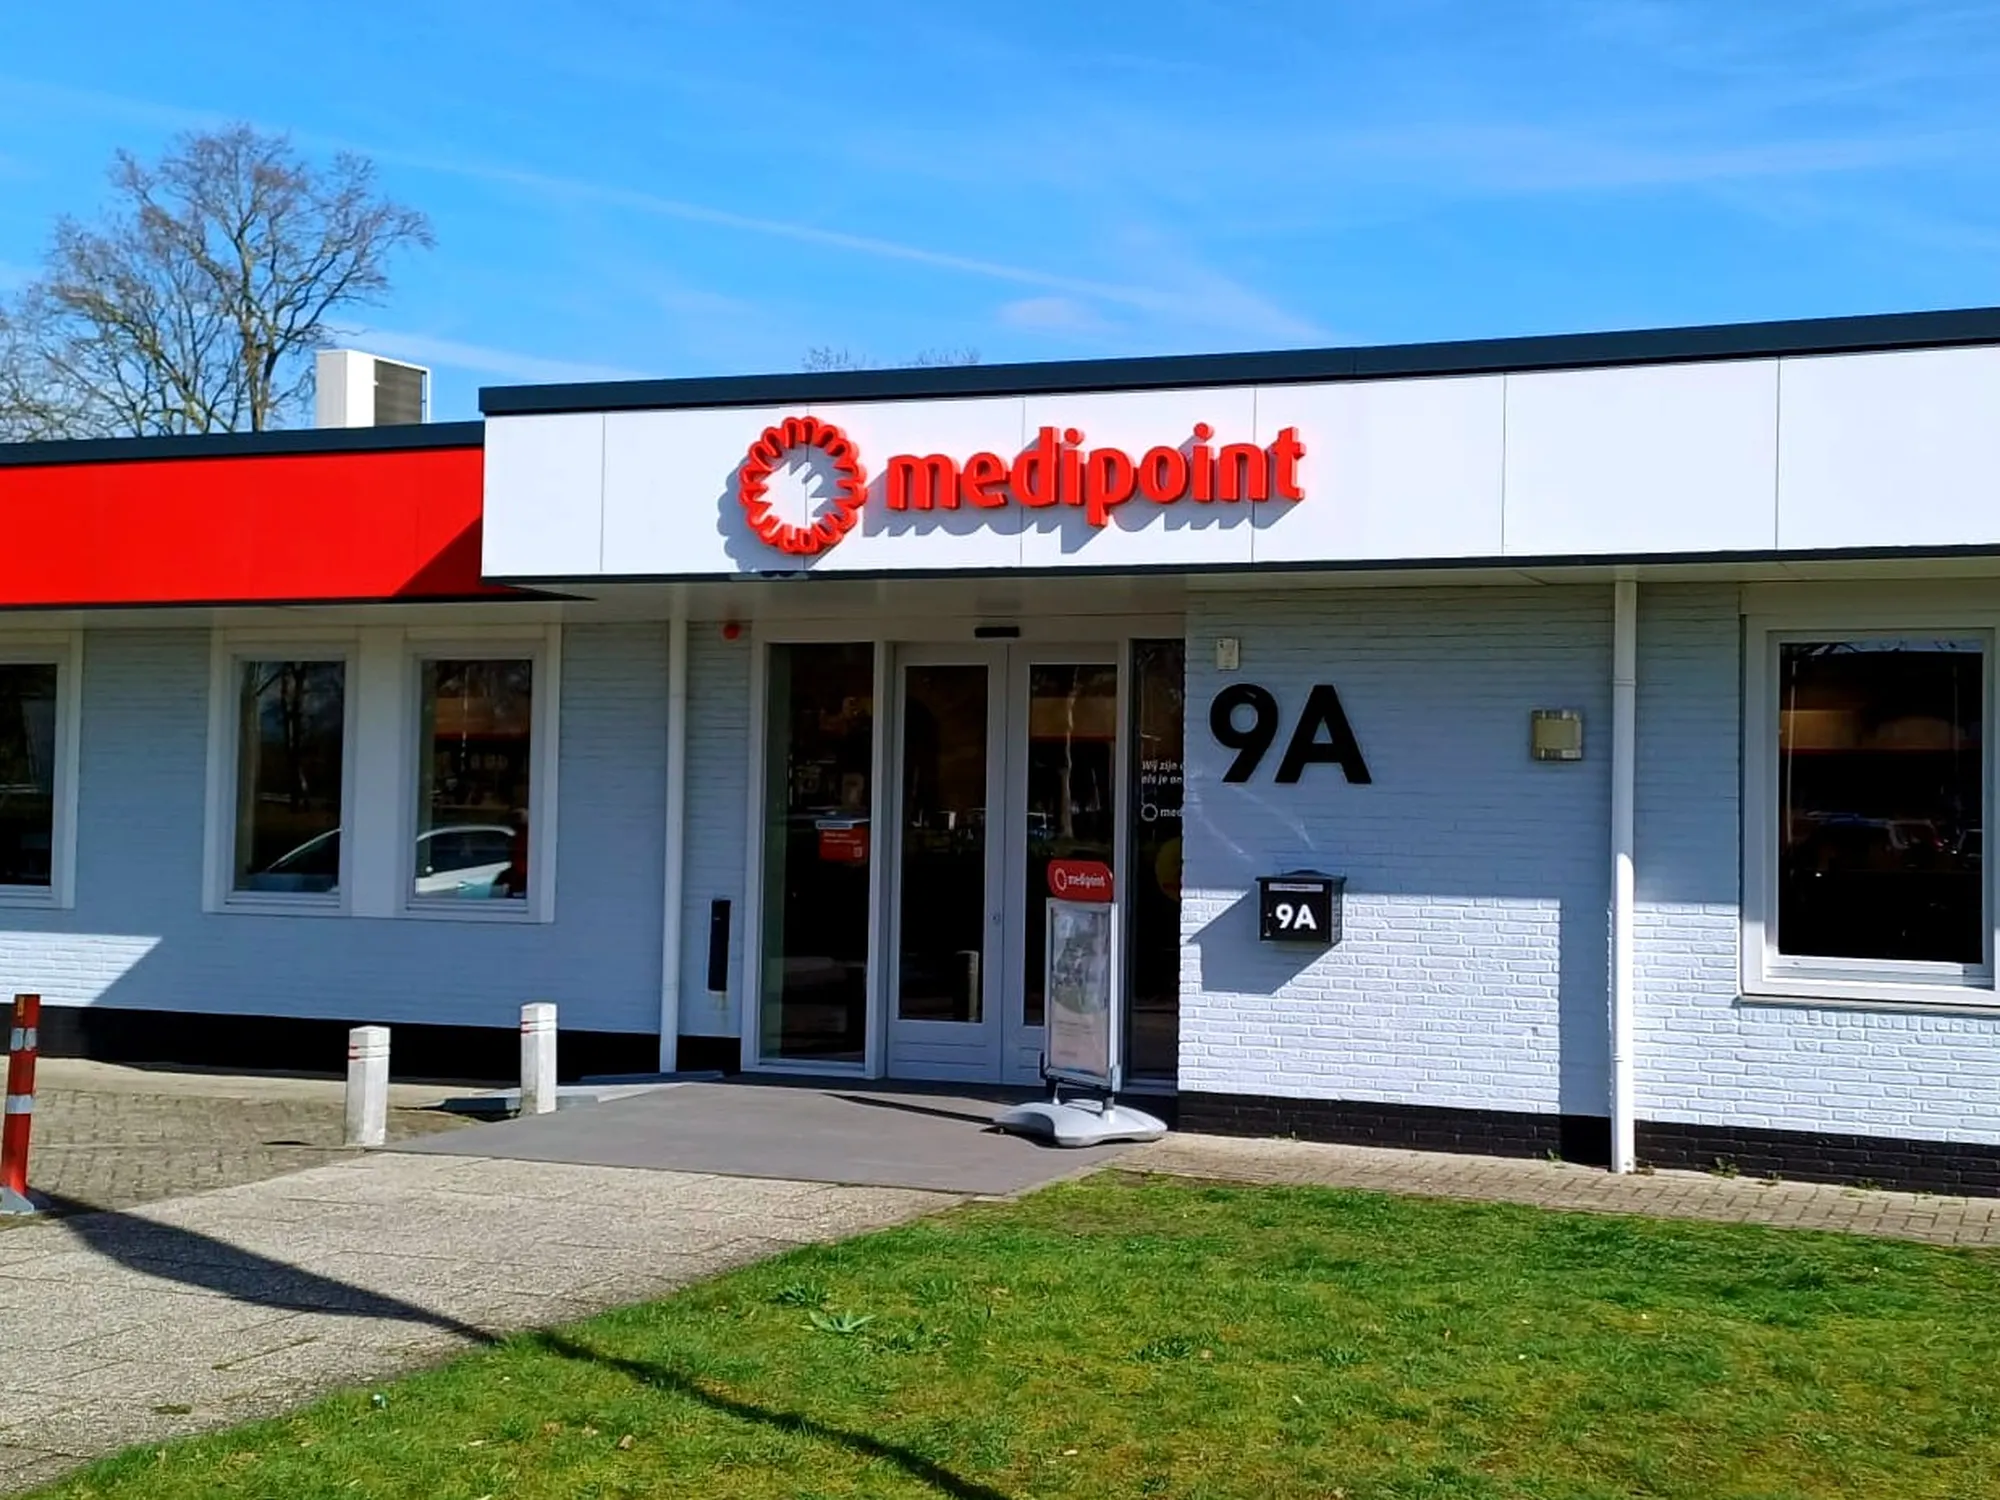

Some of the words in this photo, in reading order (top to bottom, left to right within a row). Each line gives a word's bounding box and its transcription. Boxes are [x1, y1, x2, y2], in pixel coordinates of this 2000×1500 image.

[887, 423, 1306, 527] medipoint
[1209, 683, 1372, 785] 9A
[1275, 903, 1317, 930] 9A
